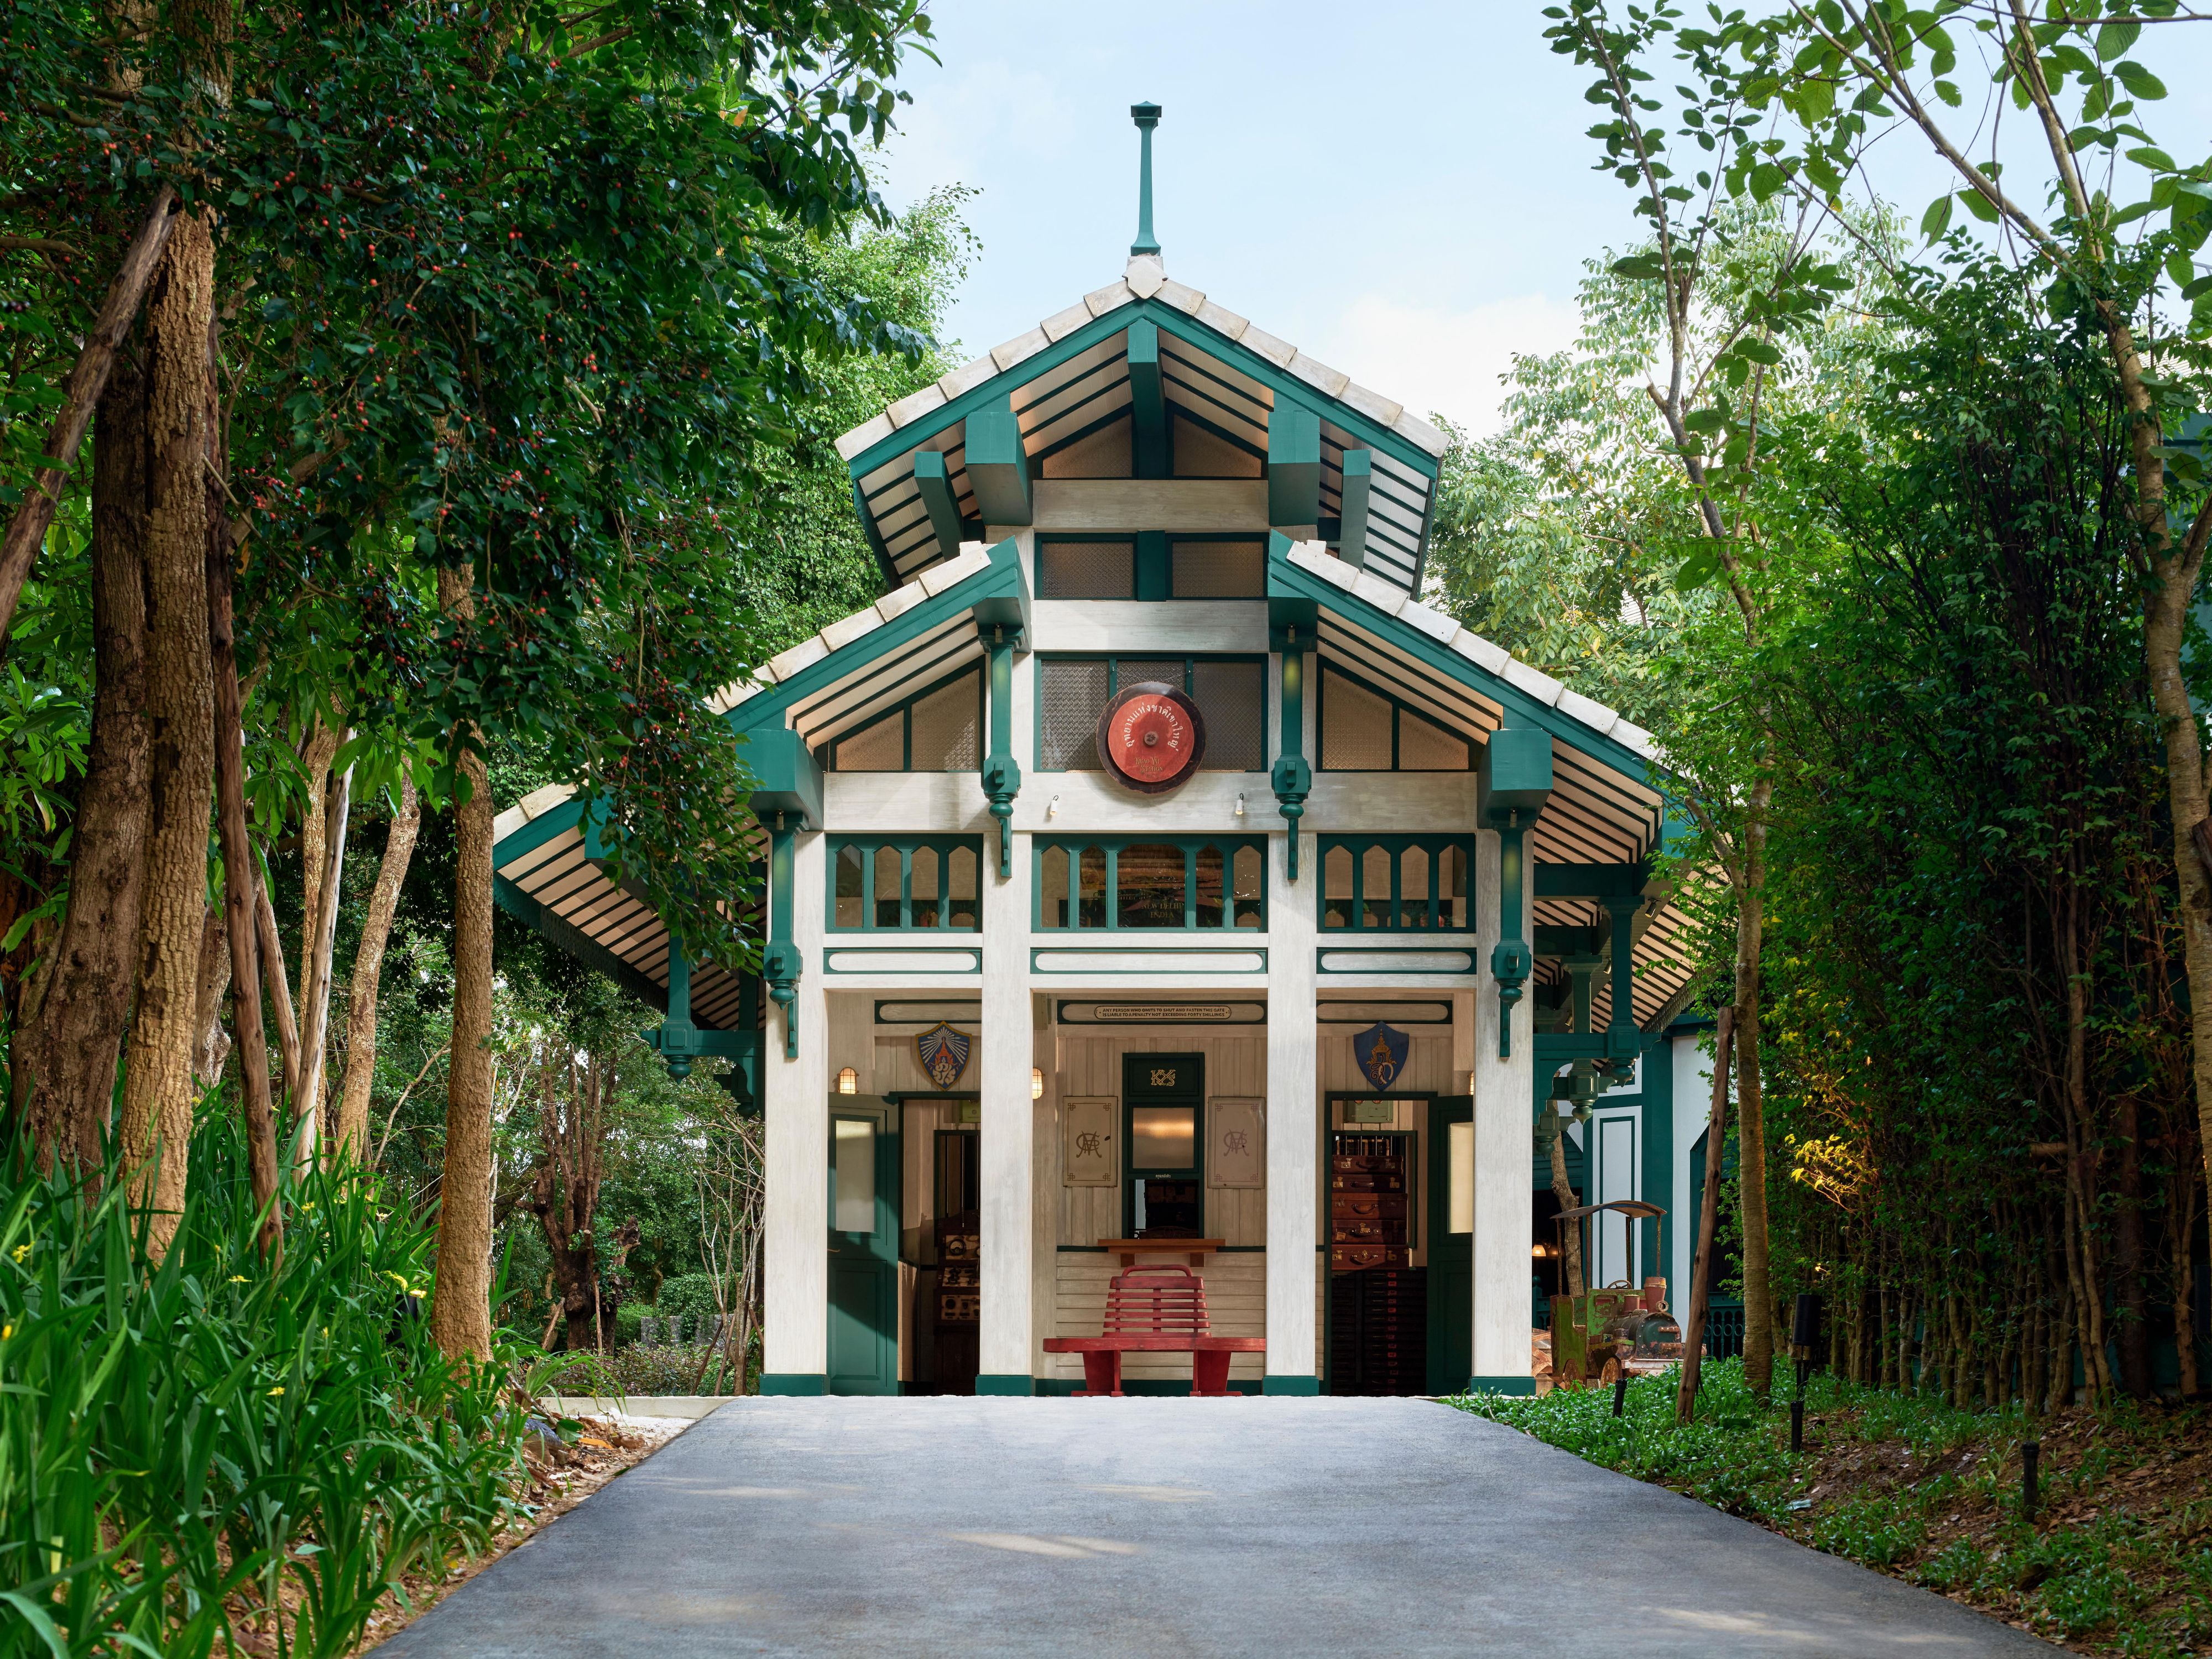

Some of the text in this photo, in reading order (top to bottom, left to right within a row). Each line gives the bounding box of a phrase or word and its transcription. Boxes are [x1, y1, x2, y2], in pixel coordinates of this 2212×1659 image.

[1124, 702, 1183, 751] อุทยานแห่งชาติเขาใหญ่
